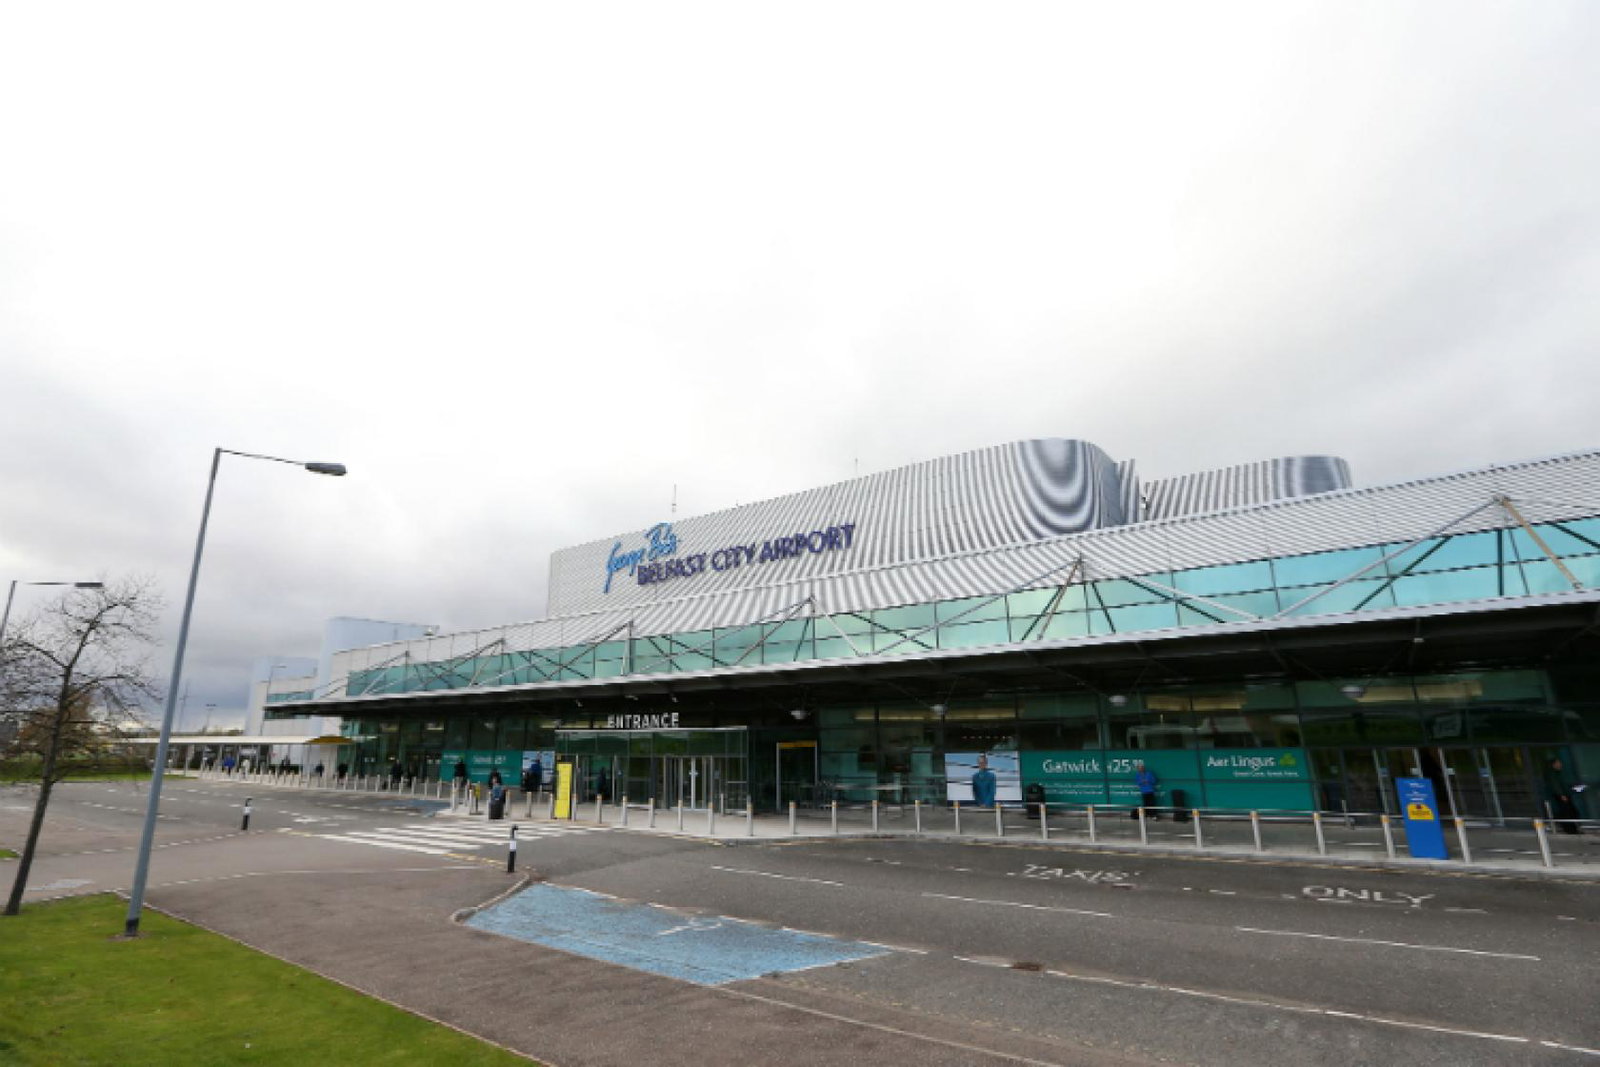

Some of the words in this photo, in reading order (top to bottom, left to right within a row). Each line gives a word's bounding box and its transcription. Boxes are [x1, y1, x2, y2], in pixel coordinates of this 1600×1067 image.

[637, 551, 707, 586] BELFAST
[711, 543, 756, 572] CITY
[758, 522, 856, 564] AIRPORT
[607, 712, 679, 729] ENTRANCE
[1042, 758, 1101, 774] Gatwick
[1207, 755, 1229, 767] Aer
[1230, 755, 1275, 771] Lingus
[1302, 885, 1436, 909] ONLY
